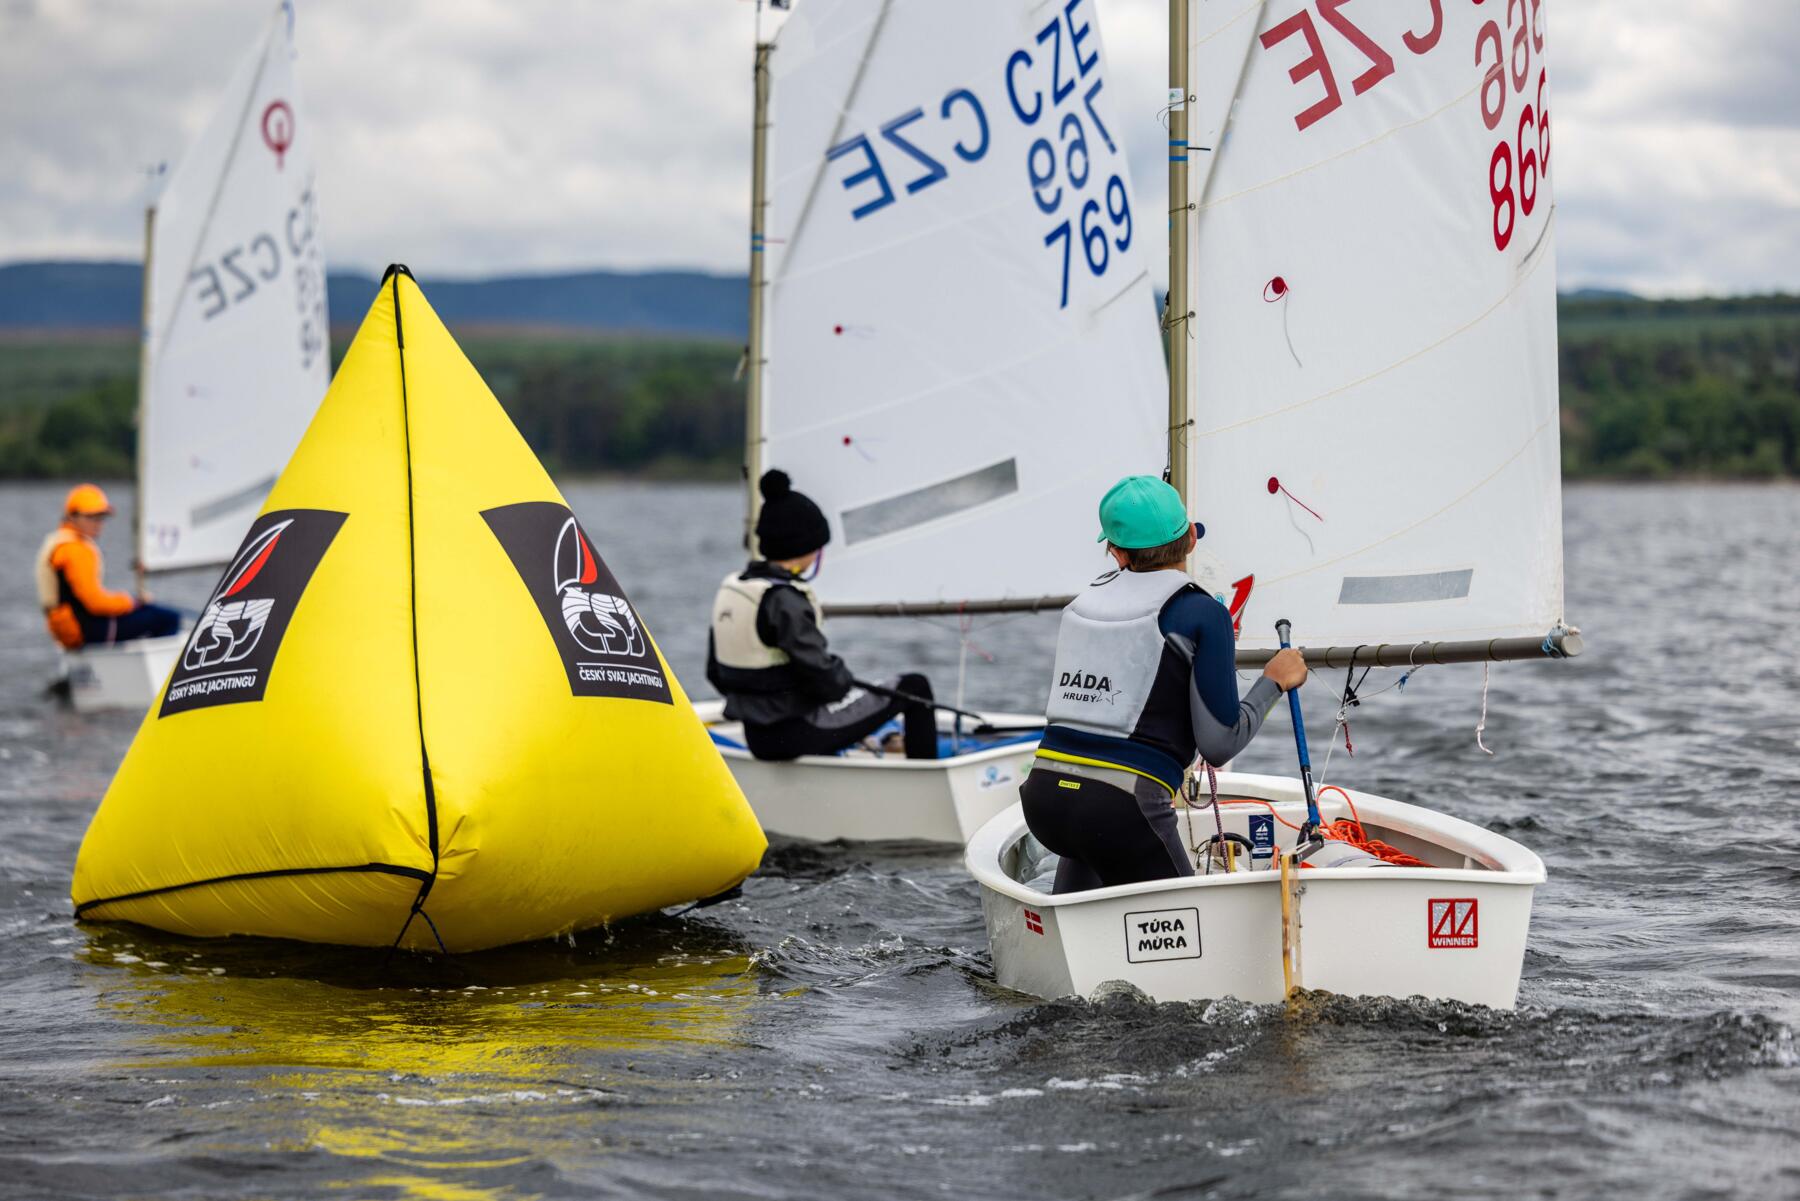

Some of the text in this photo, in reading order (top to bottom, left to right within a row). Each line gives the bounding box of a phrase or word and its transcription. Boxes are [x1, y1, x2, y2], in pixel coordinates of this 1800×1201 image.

[1006, 0, 1098, 125] CZE
[1489, 67, 1550, 251] 866
[1044, 174, 1132, 310] 769
[188, 682, 208, 696] SVAZ
[207, 675, 256, 695] JACHTINGU
[579, 666, 663, 688] ČESKÝ SVAZ JACHTINGU
[1060, 669, 1110, 692] DÁDA
[1063, 691, 1097, 702] HRUBÝ
